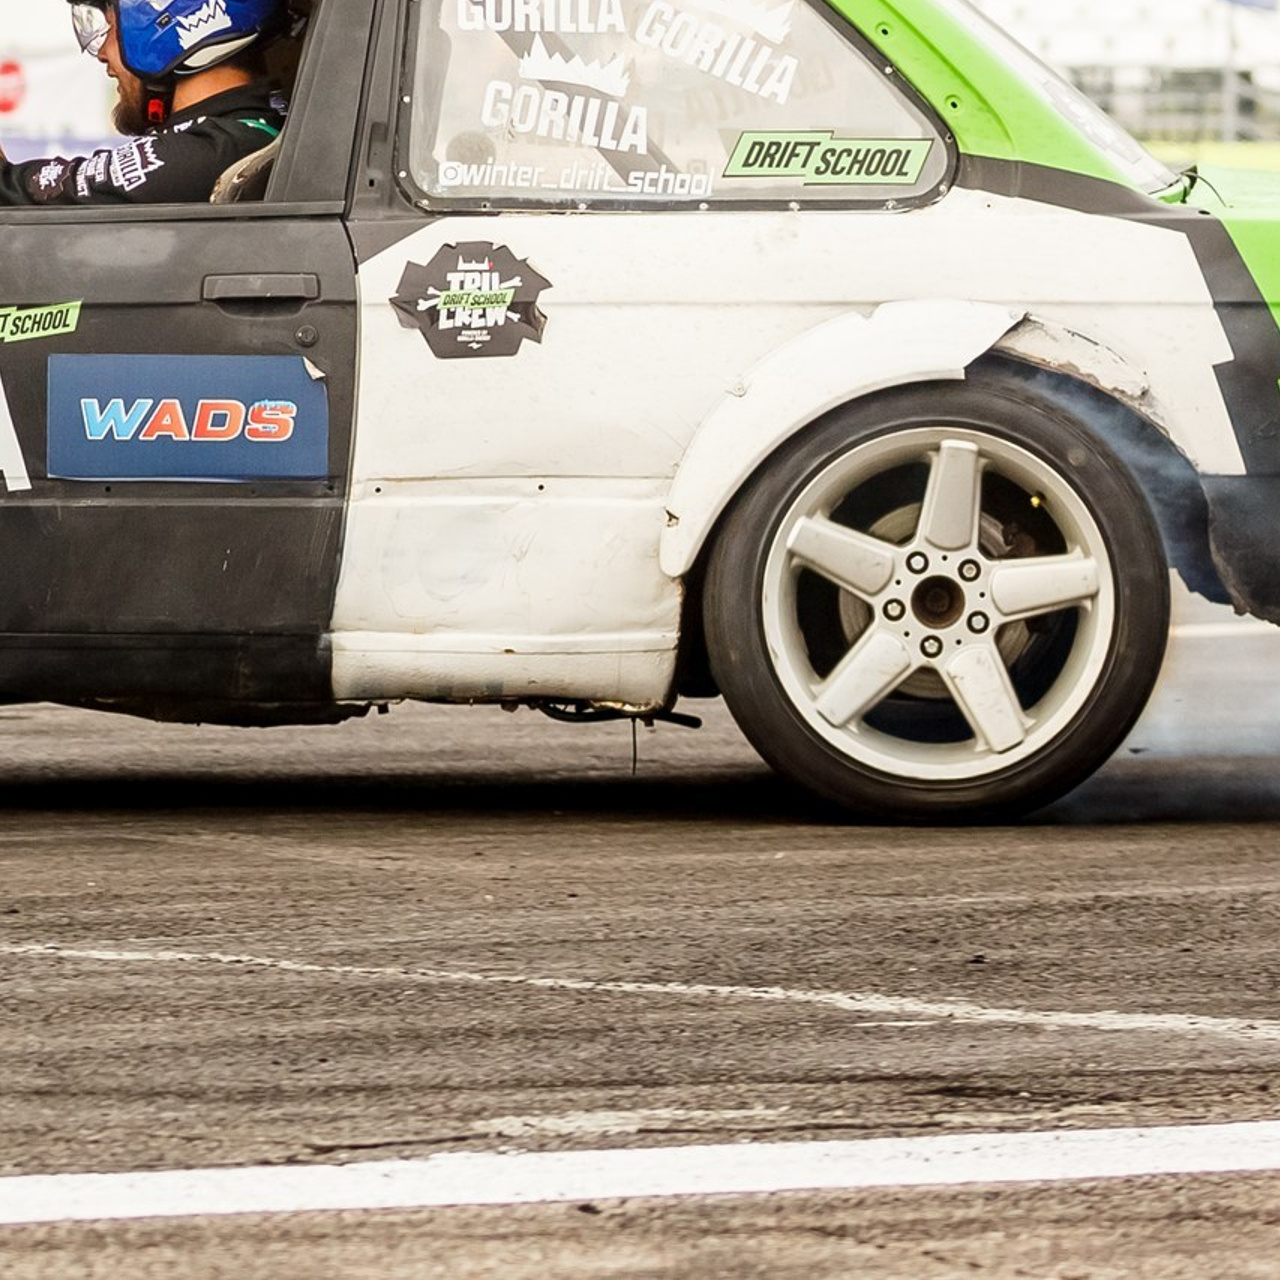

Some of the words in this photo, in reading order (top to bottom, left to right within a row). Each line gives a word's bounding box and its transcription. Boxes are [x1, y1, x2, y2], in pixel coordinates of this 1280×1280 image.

[634, 0, 800, 106] GORILLA
[481, 80, 648, 156] GORILLA
[742, 141, 821, 168] DRIFT
[814, 148, 911, 176] SCHOOL
[442, 292, 471, 306] DRIFT
[470, 292, 508, 306] SCHOOL
[10, 308, 70, 336] SCHOOL
[438, 306, 508, 330] CREW
[80, 398, 297, 442] WADS
